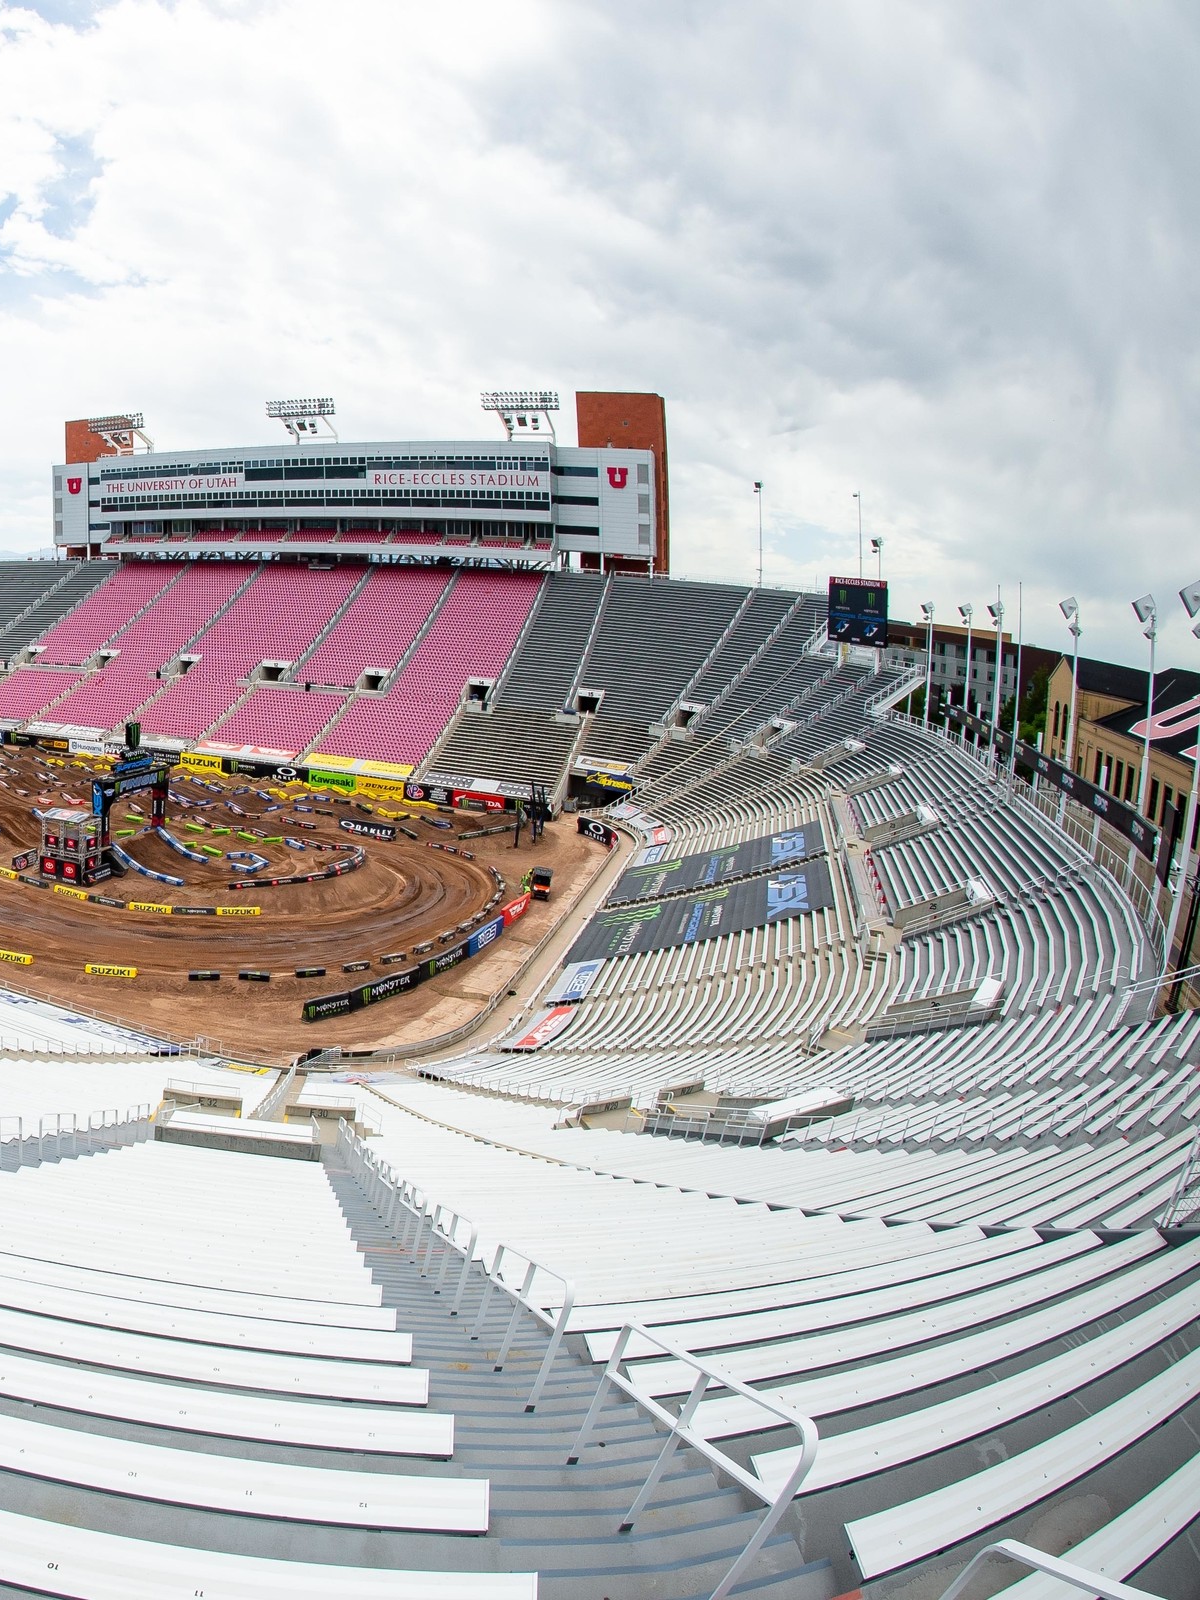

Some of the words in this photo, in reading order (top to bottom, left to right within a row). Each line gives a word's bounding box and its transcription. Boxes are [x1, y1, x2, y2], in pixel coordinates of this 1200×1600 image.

[374, 473, 465, 486] RICE-ECCLES
[470, 473, 539, 487] STADIUM
[607, 467, 629, 489] U
[66, 478, 83, 494] U
[106, 483, 124, 493] THE
[127, 479, 186, 492] UNIVERSITY
[189, 479, 203, 489] OF
[206, 477, 237, 489] UTAH
[861, 579, 881, 588] STADIUM
[77, 743, 102, 752] Husqvarna
[181, 756, 220, 769] SUZUKI
[120, 772, 158, 792] FINISH
[272, 774, 300, 782] OAKLEY
[311, 774, 354, 788] Kawasaki
[364, 782, 402, 792] DUNLOP
[355, 825, 392, 836] OAKLEY
[584, 830, 607, 843] OAKLEY
[42, 872, 57, 880] TOYOTA
[57, 887, 82, 899] SUZUKI
[133, 904, 167, 913] SUZUKI
[435, 948, 463, 968] MONSTER
[90, 966, 131, 976] SUZUKI
[371, 975, 410, 996] MONSTER
[377, 987, 404, 1000] ENERGY
[316, 999, 349, 1012] MONSTER
[321, 1007, 345, 1016] ENERGY
[207, 1098, 217, 1107] 32
[318, 1109, 328, 1118] 30
